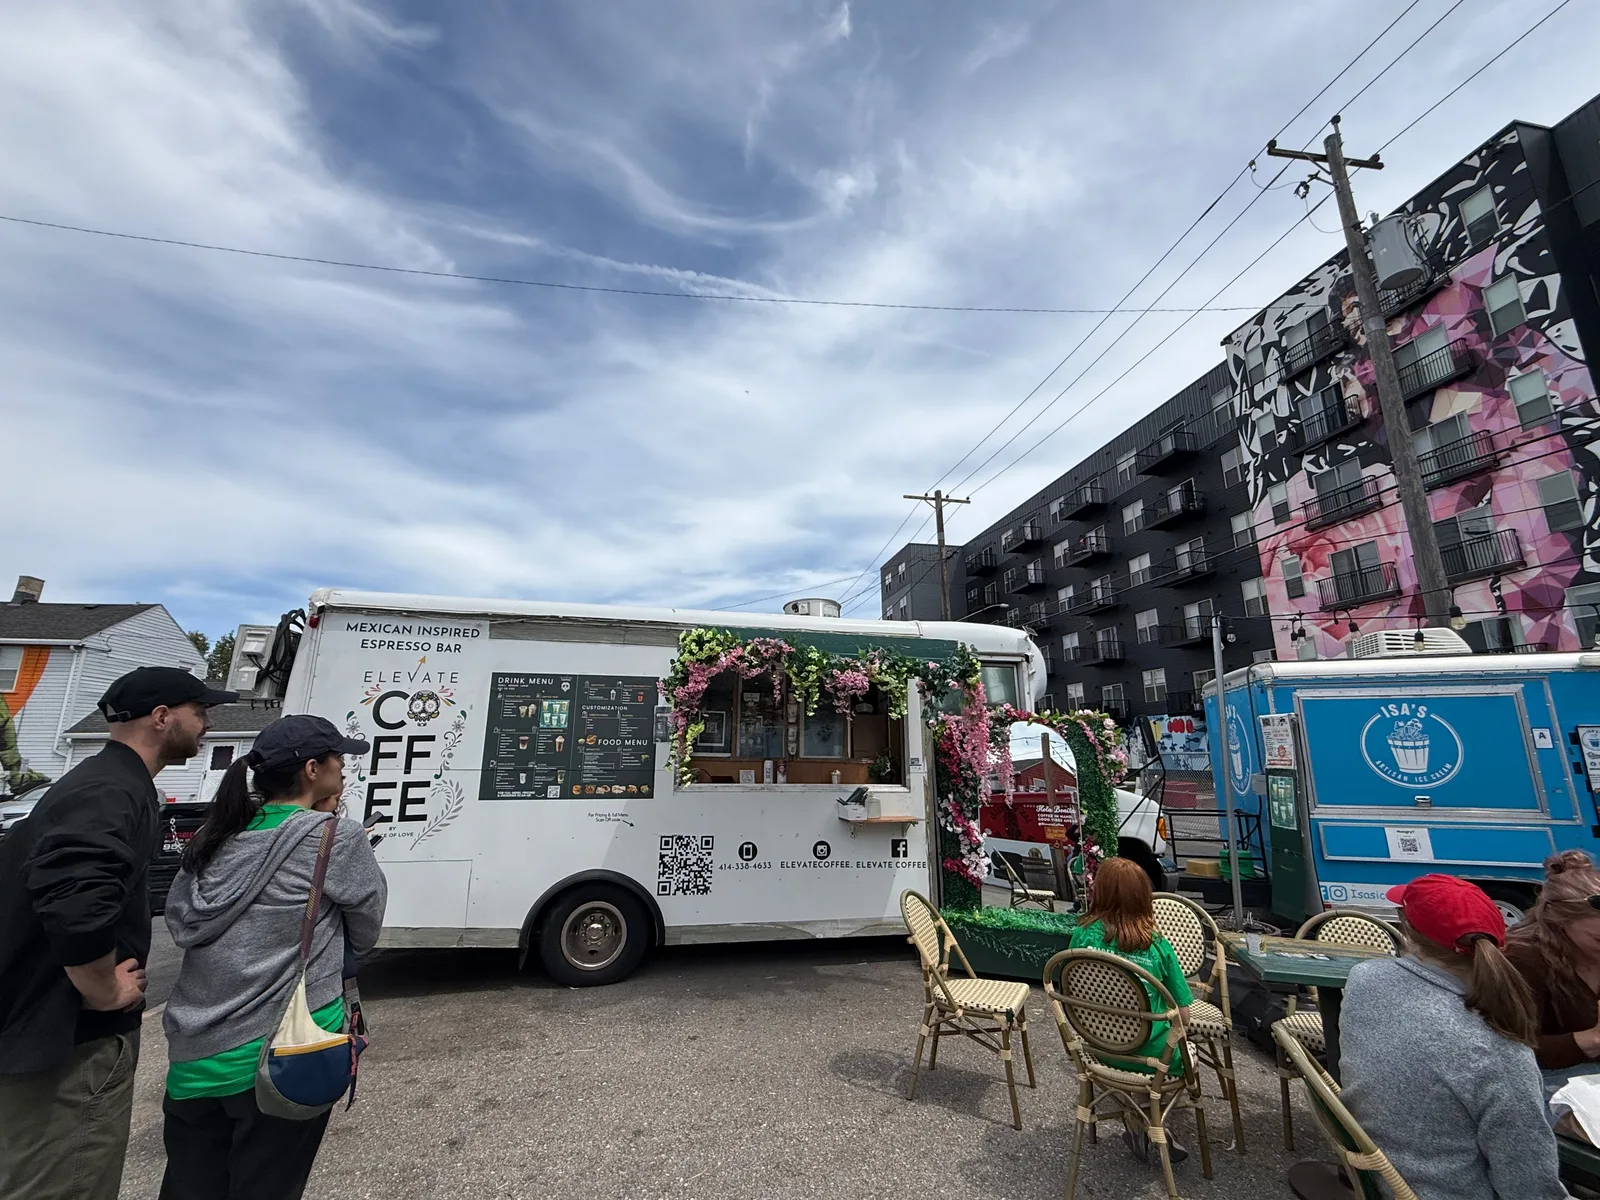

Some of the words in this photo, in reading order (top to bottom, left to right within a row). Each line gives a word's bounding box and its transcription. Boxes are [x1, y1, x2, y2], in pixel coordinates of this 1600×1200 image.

[346, 622, 412, 635] MEXICAN
[417, 625, 480, 638] INSPIRED
[360, 639, 431, 652] ESPRESSO
[436, 643, 462, 653] BAR
[363, 671, 459, 684] ELEVATE
[528, 677, 554, 685] MENU
[1380, 703, 1427, 718] ISA'S
[1538, 732, 1547, 740] A
[1375, 760, 1408, 782] ARTISAN
[1430, 763, 1453, 780] CREAM
[718, 861, 772, 870] 414-338-4633
